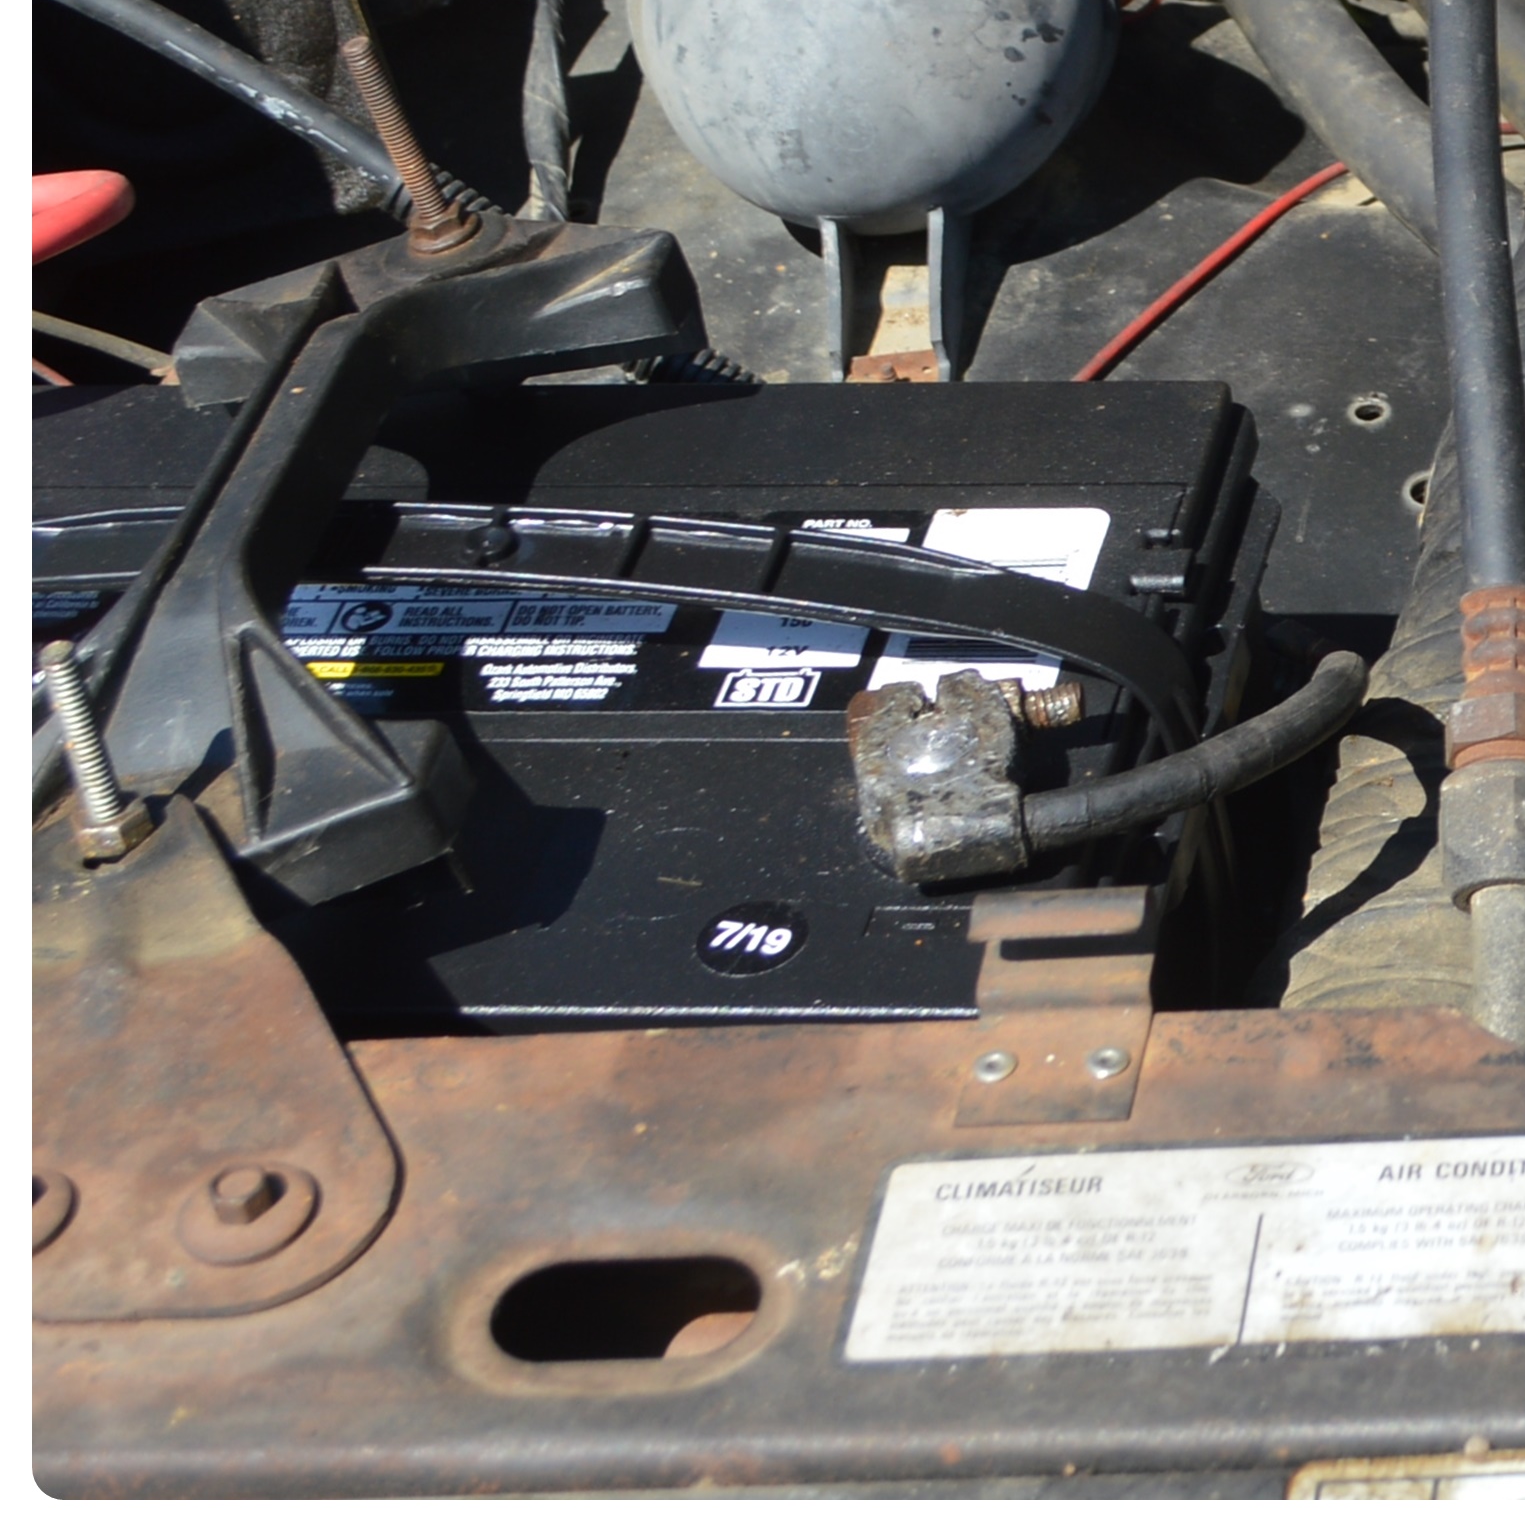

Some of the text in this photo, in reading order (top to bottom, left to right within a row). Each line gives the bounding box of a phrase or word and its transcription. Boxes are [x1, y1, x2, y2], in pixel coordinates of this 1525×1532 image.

[802, 518, 873, 528] PART NO.
[404, 605, 465, 617] READ ALL
[516, 605, 535, 616] DO
[536, 604, 564, 616] NOT
[566, 604, 602, 616] OPEN
[398, 616, 496, 628] INSTRUCTIONS.
[511, 615, 532, 626] DO
[532, 615, 561, 626] NOT
[476, 645, 543, 657] CHARGING
[542, 643, 638, 656] INSTRUCTIONS.
[766, 645, 809, 657] 12V
[319, 665, 349, 674] CALL
[480, 663, 512, 676] Ozark
[512, 662, 573, 676] Automotive
[510, 675, 543, 688] South
[543, 675, 594, 688] Patterson
[491, 687, 551, 703] Springfield
[551, 687, 572, 700] MO
[731, 676, 804, 704] STD
[709, 919, 793, 956] 7/19
[1378, 1164, 1424, 1182] AIR
[933, 1175, 1104, 1202] CLIMATISEUR
[1326, 1205, 1404, 1220] MAXIMUM
[1407, 1201, 1489, 1217] OPERATING
[1337, 1238, 1411, 1253] COMPLIES
[1415, 1236, 1454, 1250] WITH
